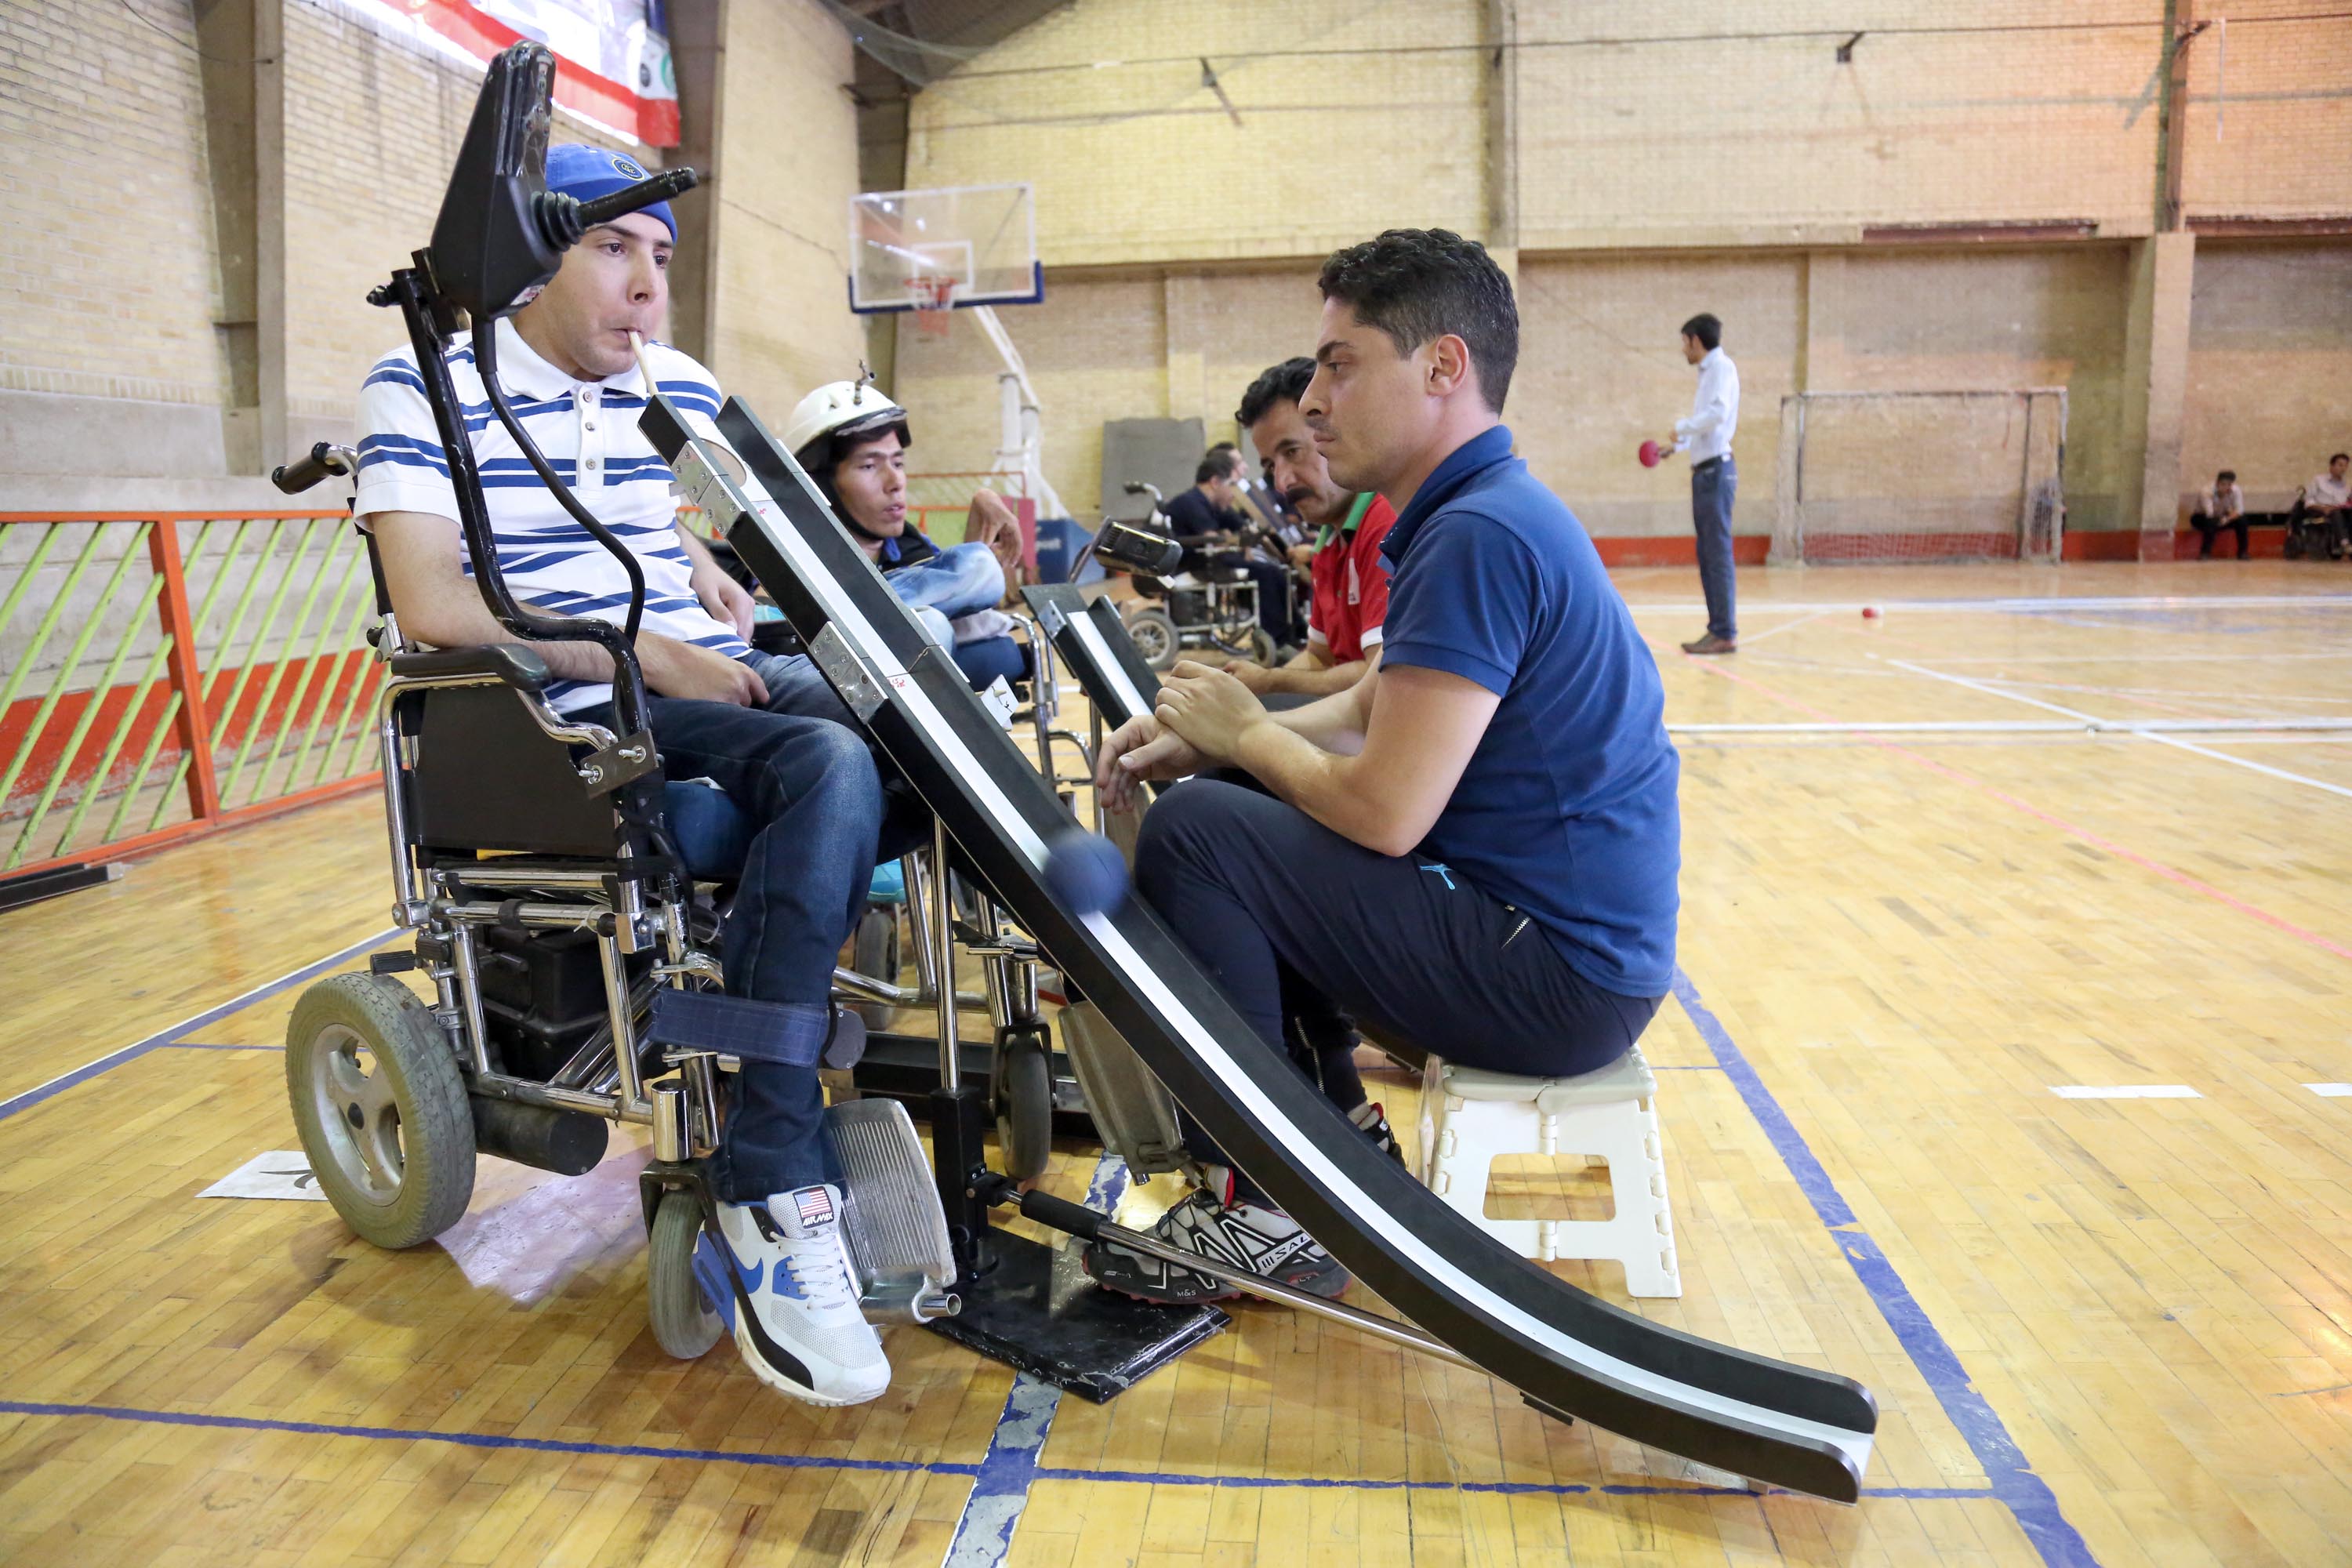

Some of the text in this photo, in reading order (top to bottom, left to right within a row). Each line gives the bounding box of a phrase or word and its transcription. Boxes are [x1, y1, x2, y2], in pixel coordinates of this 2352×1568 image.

[803, 1211, 833, 1225] AIR MAX
[1177, 1289, 1196, 1298] M&S
